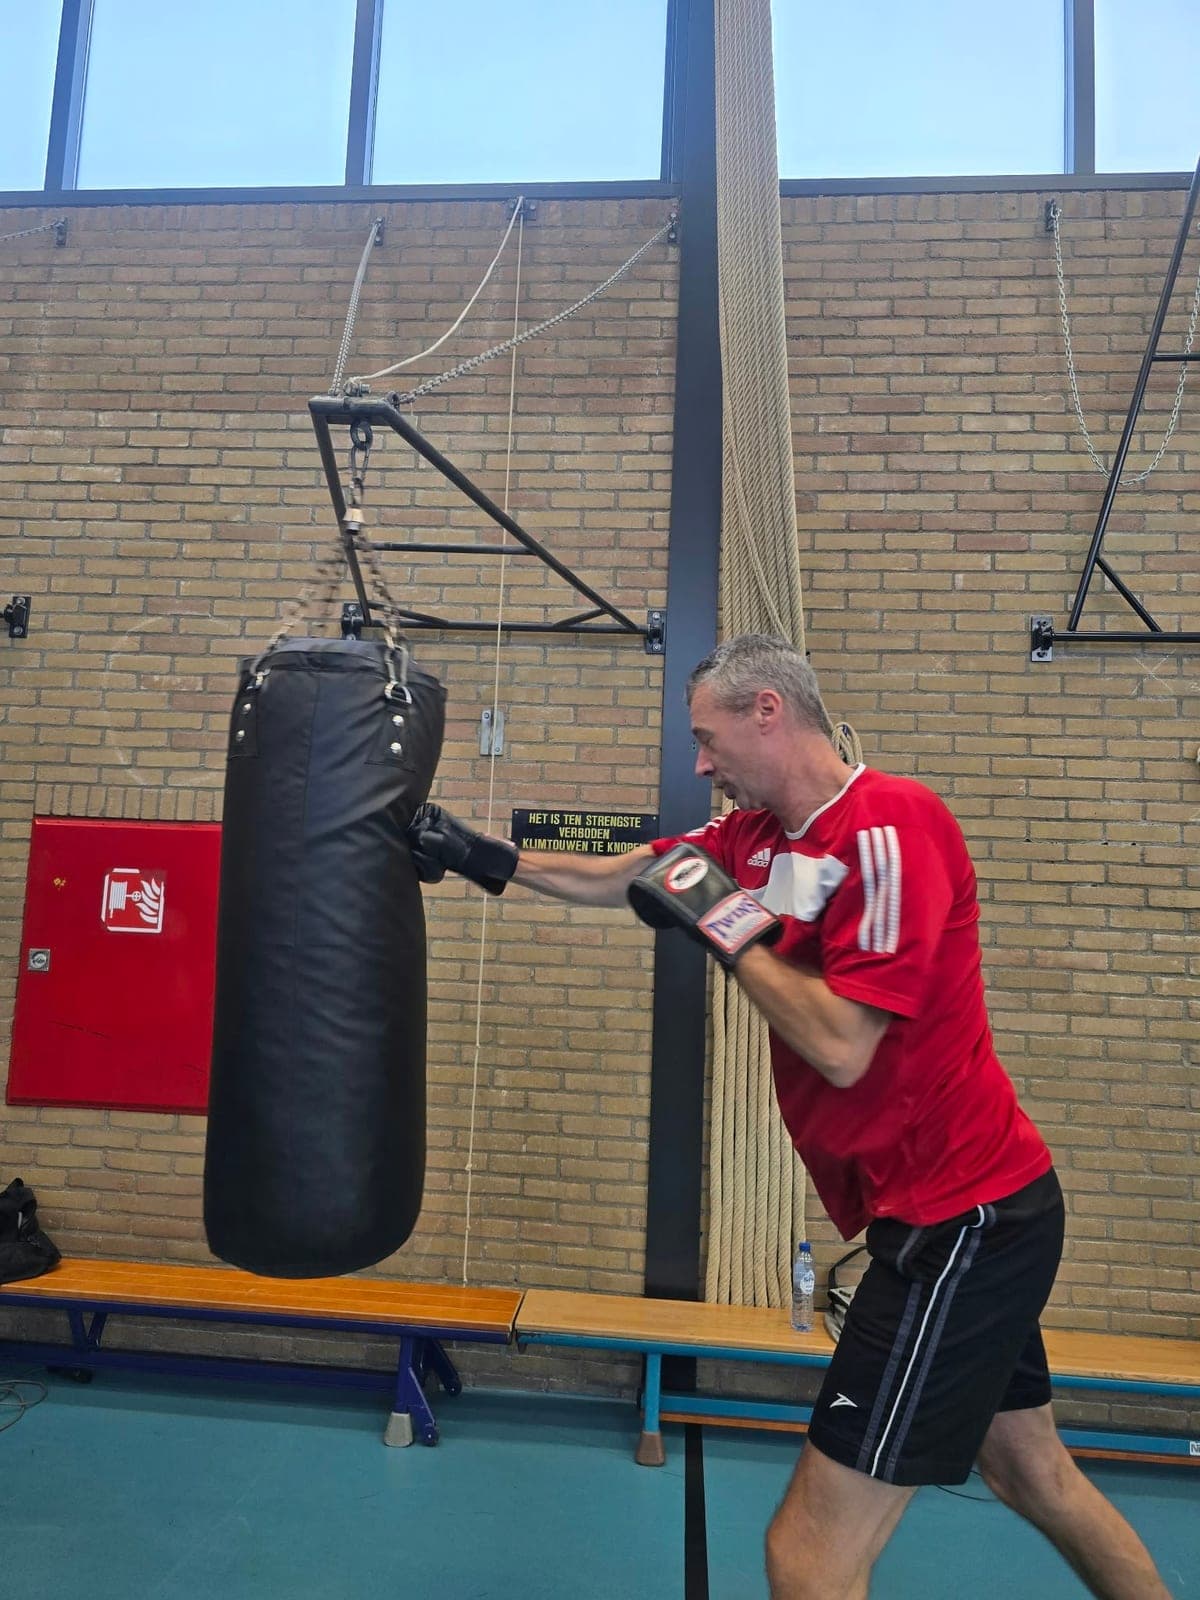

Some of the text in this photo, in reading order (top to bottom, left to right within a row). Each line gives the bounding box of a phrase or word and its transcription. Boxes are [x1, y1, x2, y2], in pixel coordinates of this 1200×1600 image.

[528, 813, 641, 828] HET IS TEN STRENGSTE
[559, 827, 610, 839] VERBODEN
[522, 838, 588, 852] KLIMTOUWEN
[592, 841, 604, 852] TE
